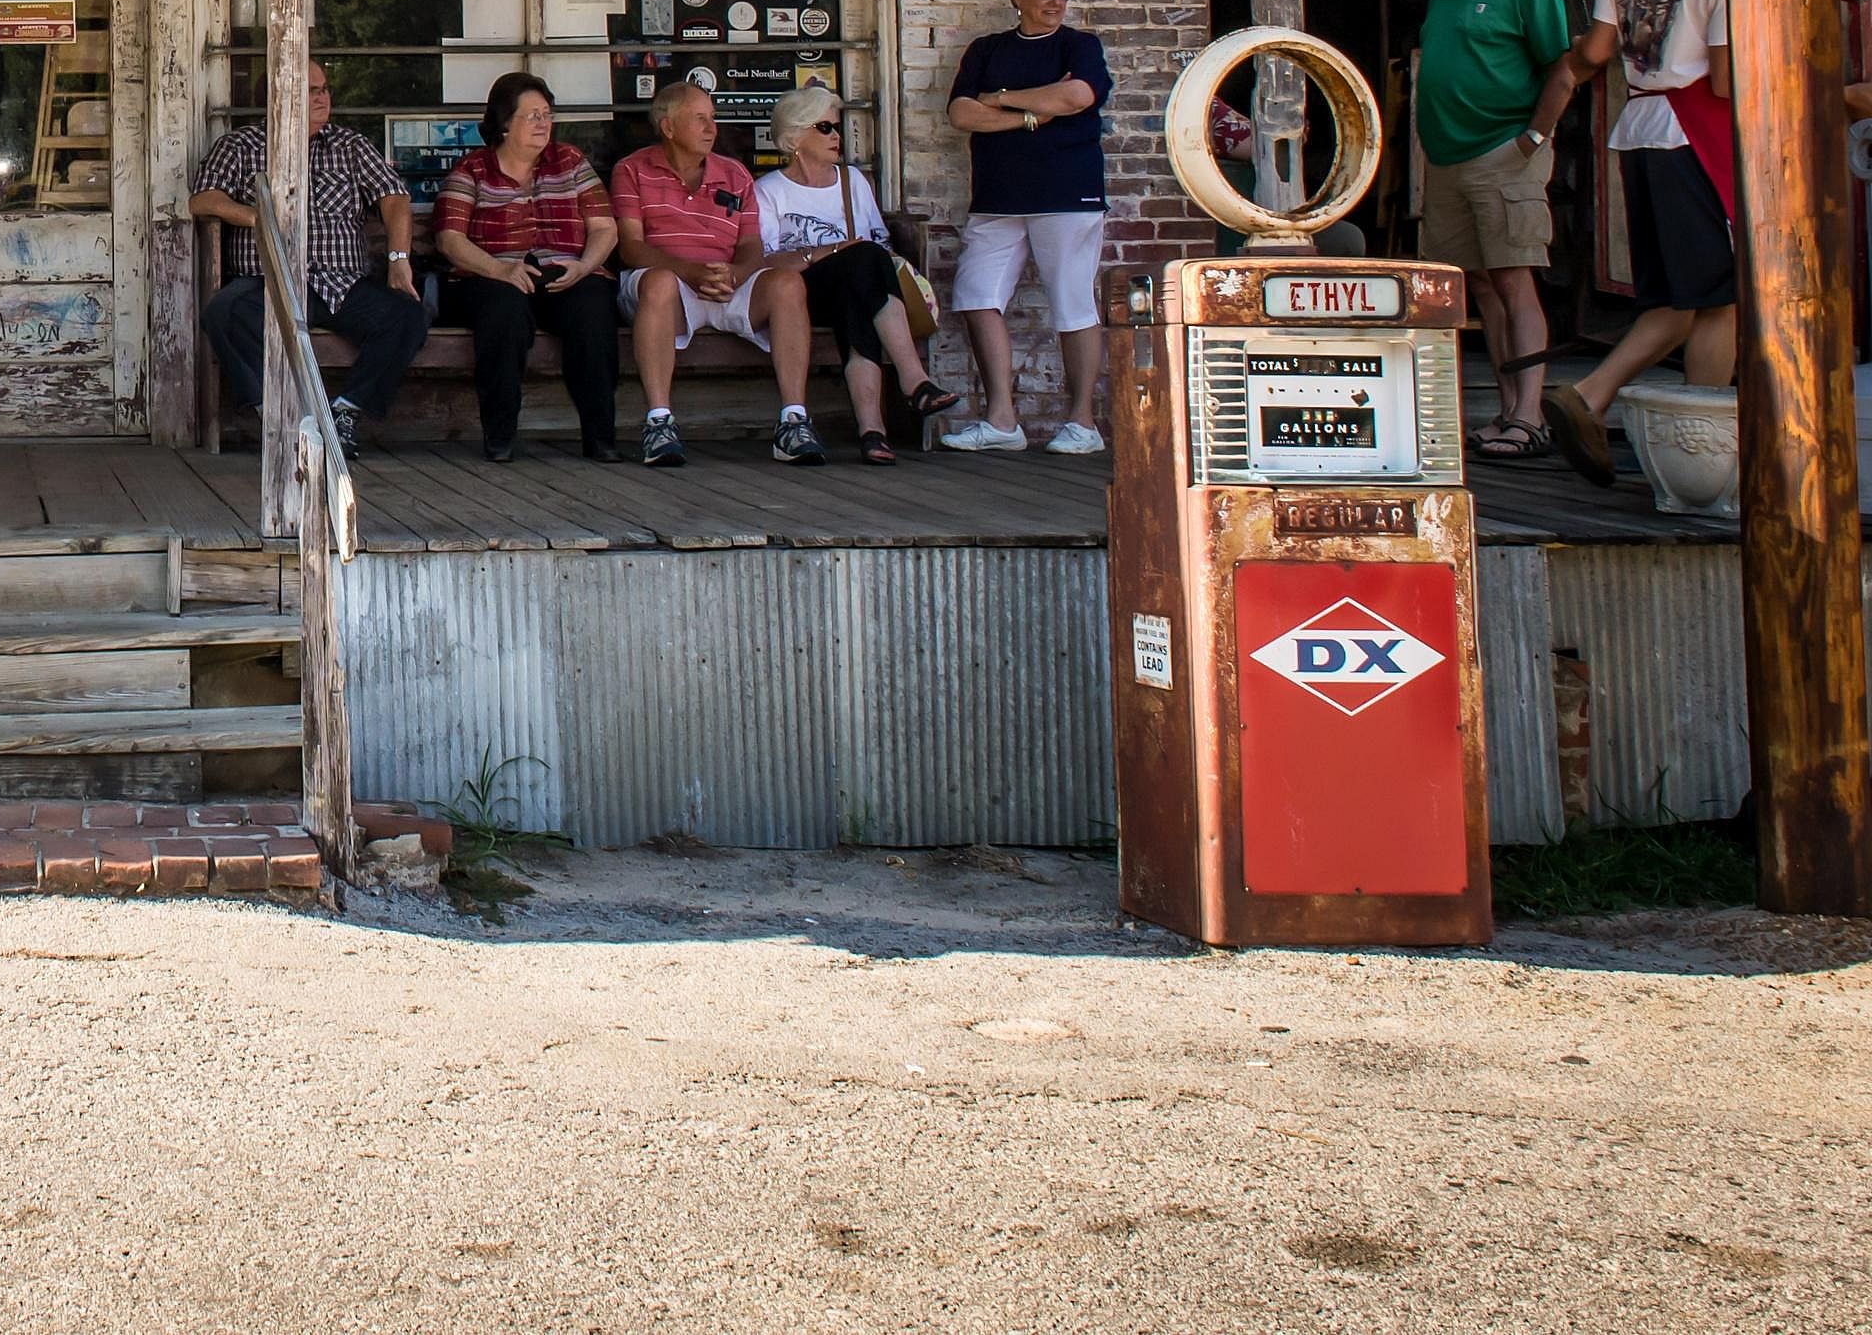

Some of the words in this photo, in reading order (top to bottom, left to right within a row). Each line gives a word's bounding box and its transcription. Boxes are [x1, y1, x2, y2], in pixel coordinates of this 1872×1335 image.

[726, 69, 749, 78] Chad
[750, 69, 791, 79] Nordhoff
[1288, 281, 1377, 313] ETHYL
[1250, 360, 1290, 371] TOTAL
[1342, 362, 1377, 372] SALE
[1279, 423, 1359, 434] GALLONS
[1286, 505, 1405, 529] REGULAR
[1137, 639, 1168, 656] CONTAINS
[1291, 637, 1407, 674] DX
[1141, 655, 1164, 672] LEAD
